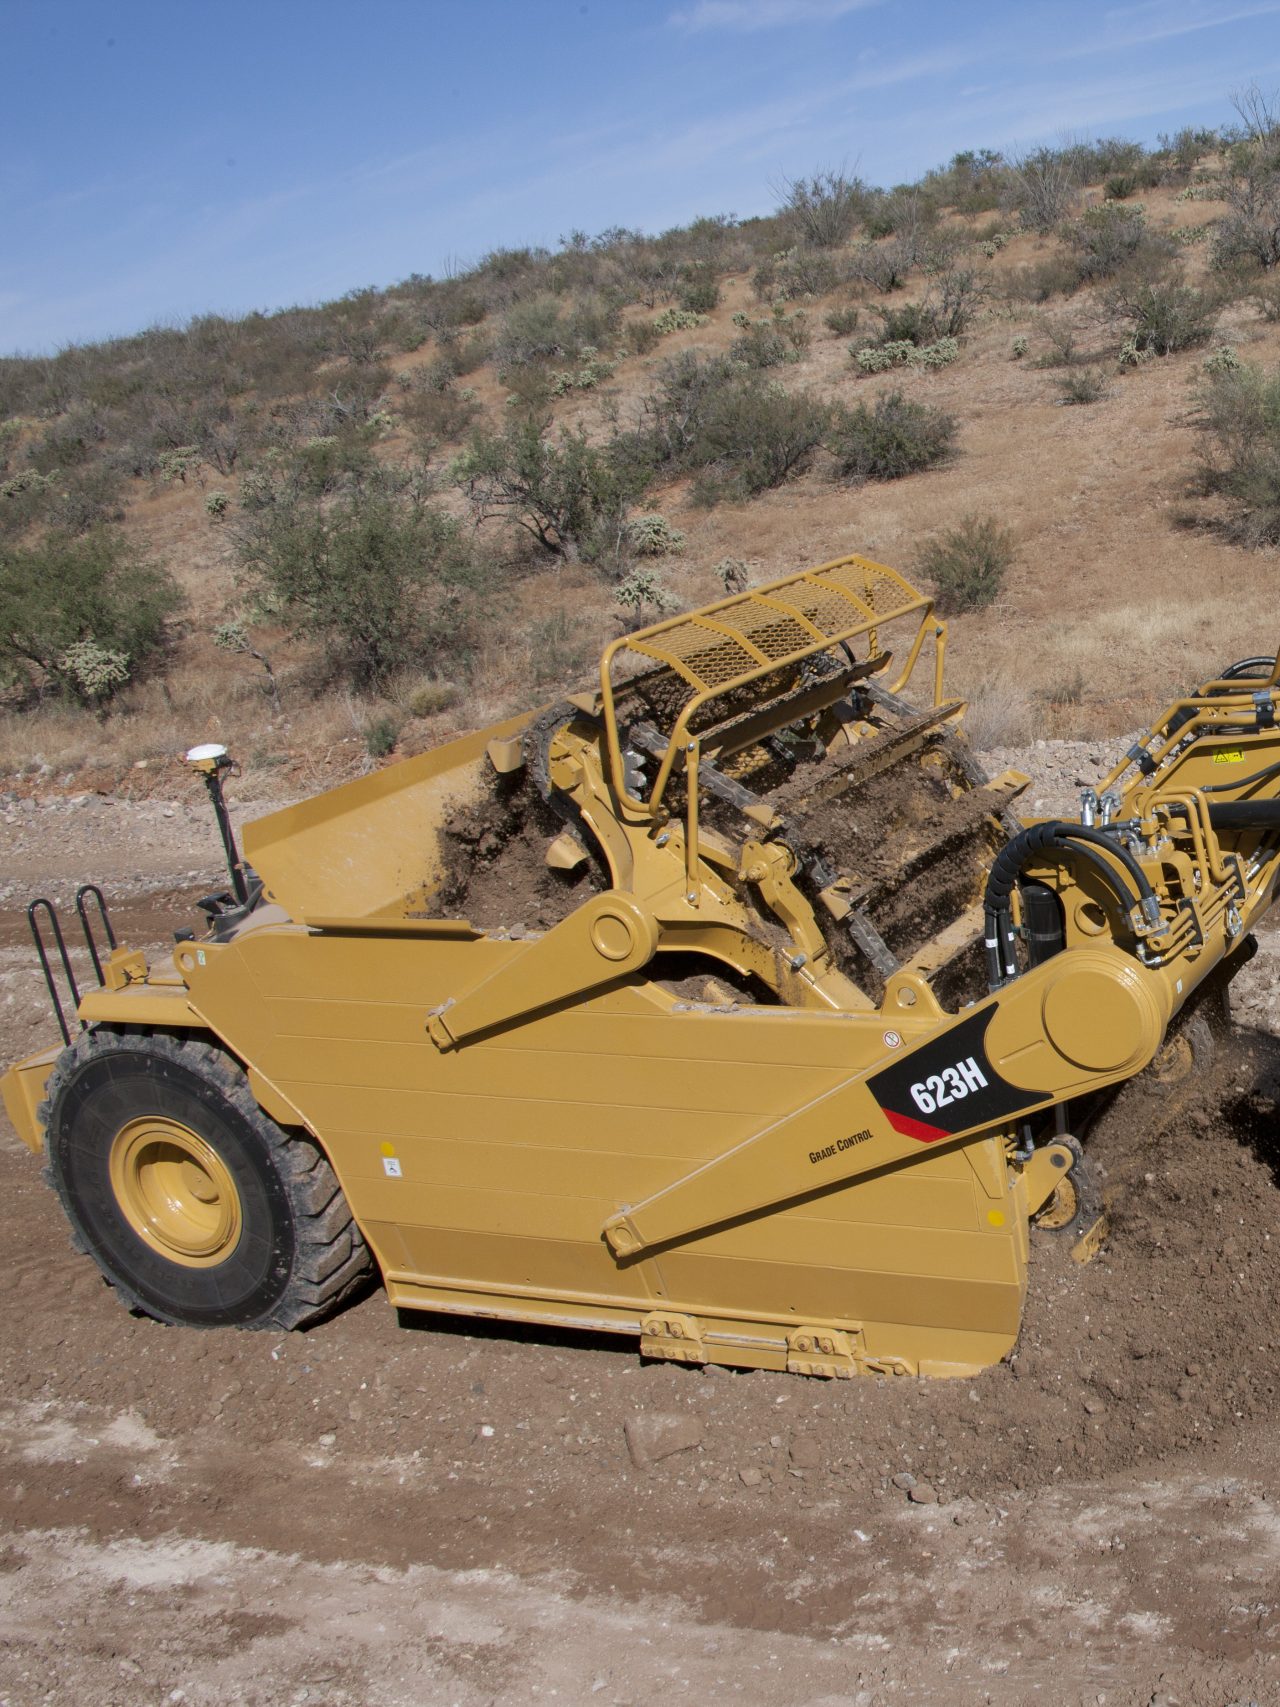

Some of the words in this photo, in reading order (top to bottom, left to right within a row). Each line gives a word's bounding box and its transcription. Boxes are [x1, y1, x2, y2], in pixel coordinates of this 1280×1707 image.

[910, 1056, 989, 1114] 623H
[809, 1145, 837, 1164] GRADE
[836, 1128, 874, 1152] CONTROL
